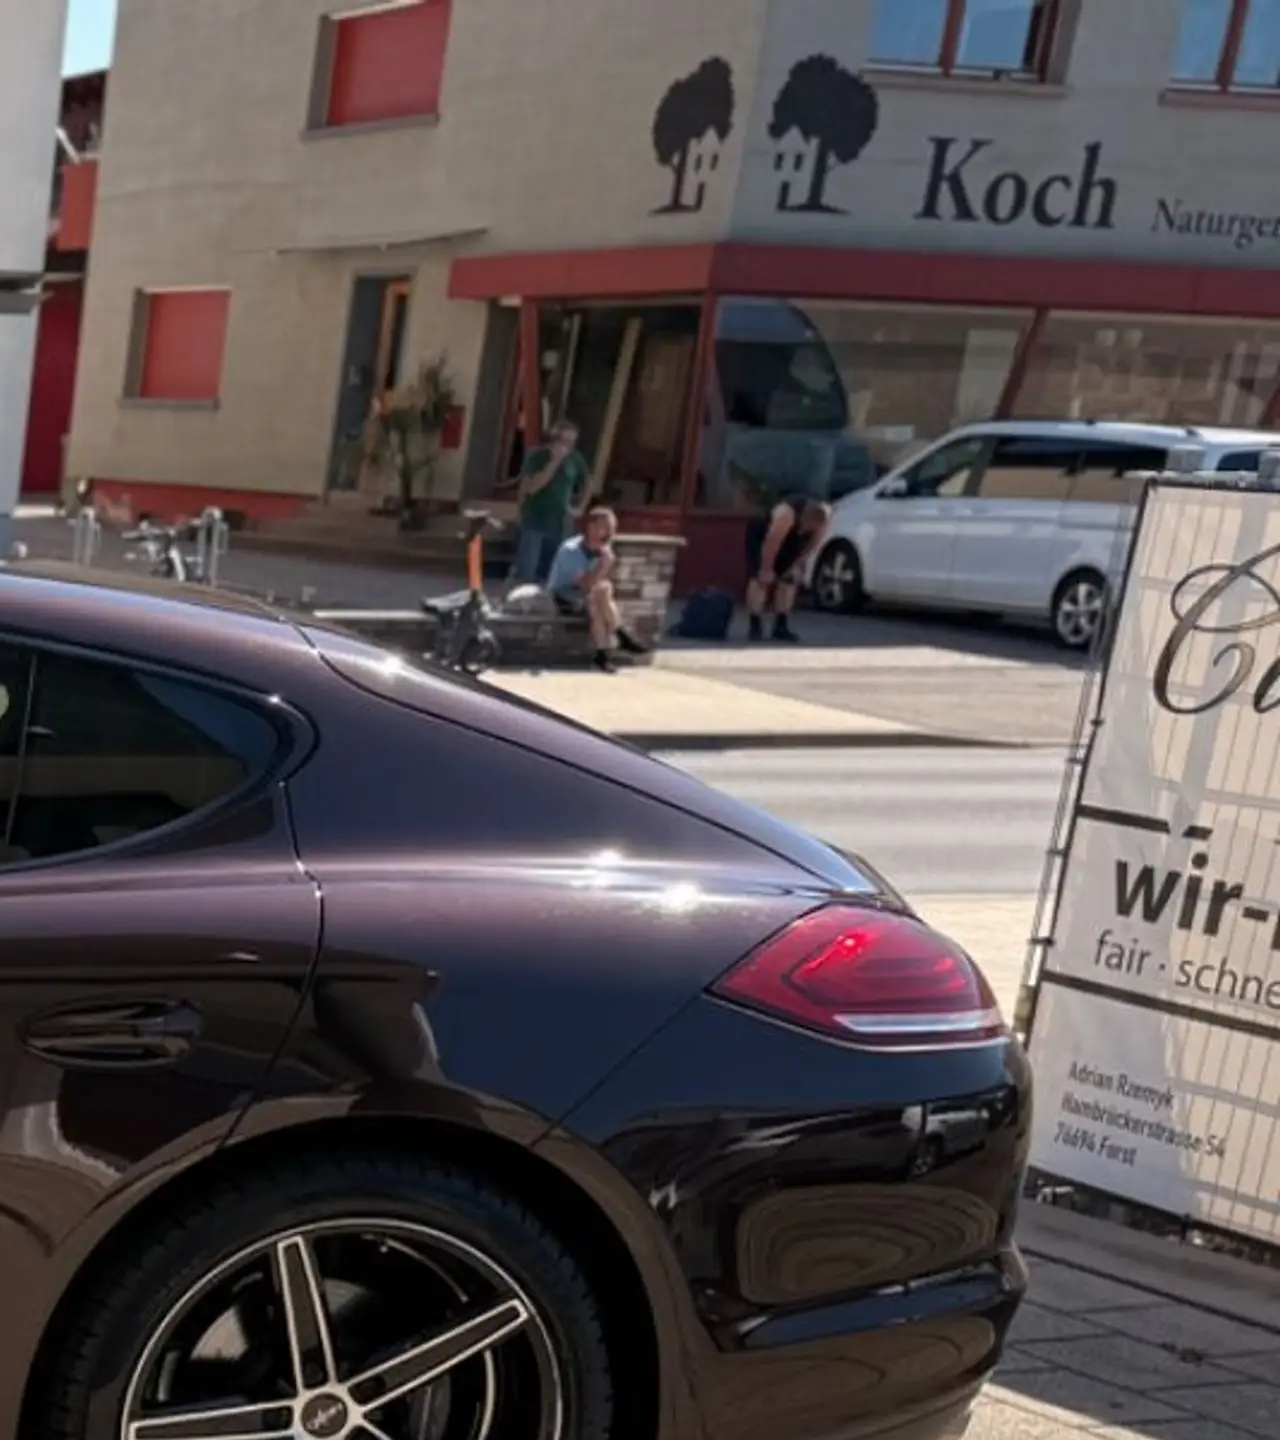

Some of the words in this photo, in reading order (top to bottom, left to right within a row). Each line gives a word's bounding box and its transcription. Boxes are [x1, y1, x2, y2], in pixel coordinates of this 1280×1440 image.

[912, 136, 1118, 230] Koch
[1115, 852, 1280, 951] wir-
[1094, 928, 1152, 976] fair
[1068, 1061, 1114, 1092] Adrian
